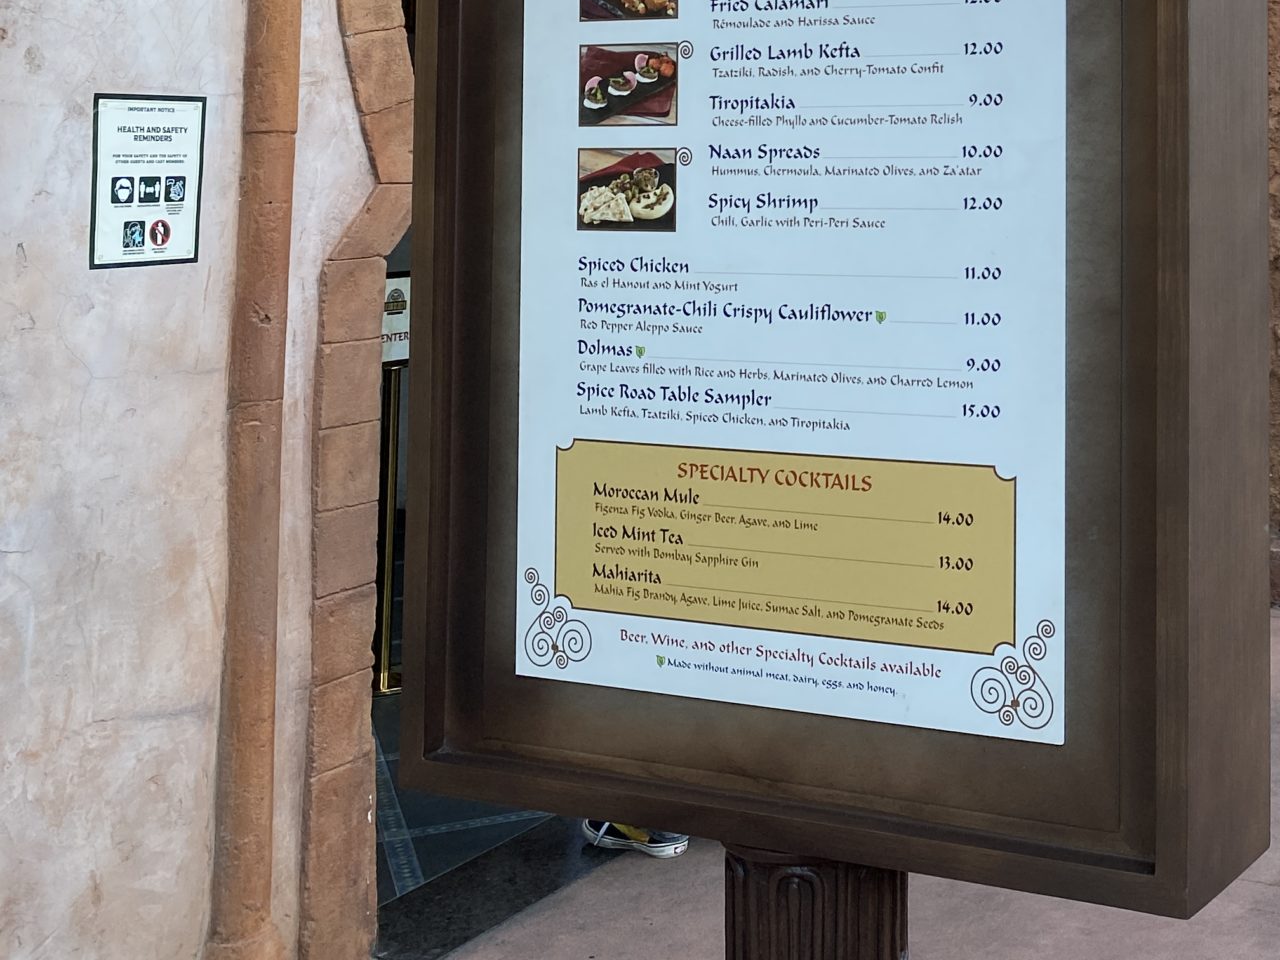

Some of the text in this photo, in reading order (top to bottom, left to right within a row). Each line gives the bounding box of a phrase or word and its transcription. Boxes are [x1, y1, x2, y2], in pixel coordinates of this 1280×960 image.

[713, 15, 875, 29] Rémoulade and Harissa Sauce
[710, 41, 1003, 61] Grilled Lamb Kefta 12.00
[712, 67, 752, 78] Tzatziki,
[800, 67, 820, 76] and
[824, 65, 907, 78] Cherry-Tomato
[911, 62, 943, 73] Confit
[709, 93, 1003, 114] Tiropitakia 9.00
[712, 113, 962, 129] Cheese-filled Phyllo and Cucumber-Tomato Relish
[709, 144, 1002, 163] Naan Spreads 10.00
[825, 166, 879, 176] Marinated
[919, 167, 939, 176] and
[709, 192, 1002, 214] Spicy Shrimp 12.00
[711, 216, 885, 228] Chili, Garlic with Peri-Peri Sauce
[579, 256, 1001, 280] Spiced Chicken 11.00
[581, 277, 597, 287] Ras
[613, 279, 649, 289] Hanout
[653, 281, 671, 289] and
[675, 280, 700, 290] Mint
[703, 281, 737, 294] Yogurt
[578, 298, 1001, 325] Pomegranate-Chili Crispy Cauliflower 11.00
[581, 319, 702, 335] Red Pepper Aleppo Sauce
[577, 339, 1000, 372] Dolmas 9.00
[580, 361, 606, 375] Grape
[610, 362, 639, 373] Leaves
[643, 363, 665, 375] filled
[669, 365, 691, 376] with
[695, 366, 714, 377] Rice
[717, 370, 735, 378] and
[773, 370, 827, 382] Marinated
[867, 376, 887, 385] and
[890, 374, 933, 387] Charred
[937, 377, 973, 388] Lemon
[577, 382, 1000, 418] Spice Road Table Sampler 15.00
[580, 405, 607, 415] Lamb
[686, 411, 718, 424] Spiced
[769, 418, 788, 427] and
[791, 417, 850, 431] Tiropitakia
[678, 463, 872, 492] SPECIALTY COCKTAILS
[594, 482, 973, 526] Moroccan Mule 14.00
[595, 502, 628, 516] Figenza
[632, 505, 645, 519] Fig
[680, 510, 711, 524] Ginger
[772, 520, 791, 528] and
[795, 519, 818, 531] Lime
[593, 522, 973, 571] Iced Mint Tea 13.00
[595, 543, 758, 568] Served with Bombay Sapphire Gin
[593, 563, 973, 615] Mahiarita 14.00
[595, 583, 623, 596] Mahia
[627, 587, 640, 601] Fig
[713, 596, 735, 608] Lime
[766, 601, 799, 615] Sumac
[826, 611, 845, 620] and
[848, 609, 914, 627] Pomegranate
[916, 617, 944, 630] Seeds
[651, 633, 688, 648] Wine,
[692, 641, 715, 651] and
[719, 641, 752, 655] other
[756, 645, 813, 667] Specialty
[819, 652, 876, 670] Cocktails
[880, 661, 941, 678] available
[668, 658, 691, 669] Made
[694, 662, 728, 673] without
[731, 668, 762, 677] animal
[847, 682, 864, 690] and
